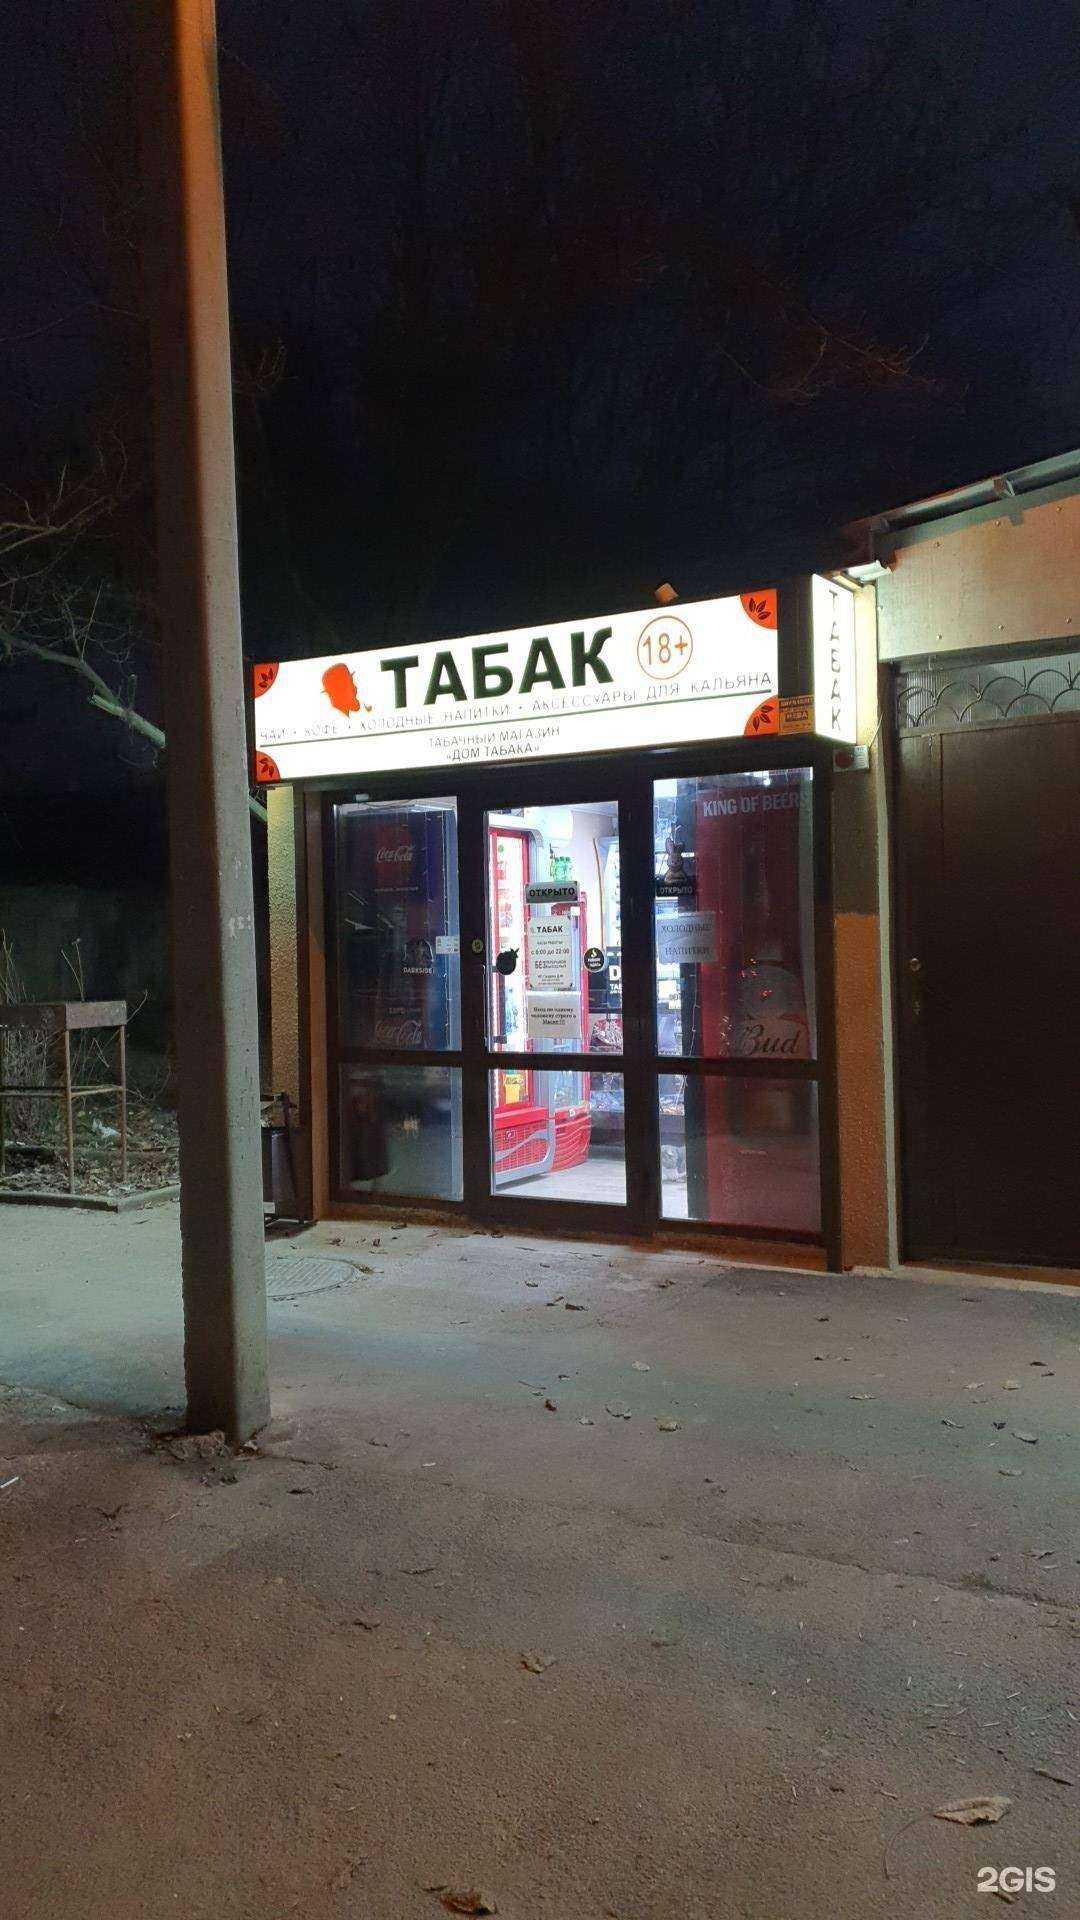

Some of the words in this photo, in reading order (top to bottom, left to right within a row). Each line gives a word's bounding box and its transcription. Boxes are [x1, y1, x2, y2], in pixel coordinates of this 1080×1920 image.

[643, 632, 689, 666] 18+
[380, 626, 614, 709] ТАБАК
[828, 590, 842, 732] ТАБАК
[360, 714, 433, 732] ХОЛОДНЫЕ
[444, 704, 511, 722] НАПИТКИ
[532, 689, 637, 712] АКСЕССУАРЫ
[646, 683, 681, 702] ДЛЯ
[691, 672, 773, 693] КАЛЬЯНА
[428, 732, 496, 748] ТАБАЧНЫЙ
[499, 726, 561, 742] МАГАЗИН
[703, 798, 738, 817] KING
[740, 796, 761, 813] OF
[529, 886, 576, 898] ОТКРЫТО
[660, 886, 693, 895] ОТКРЫТО
[536, 925, 563, 934] ТАБАК
[403, 966, 433, 975] DARKSIDE
[741, 1023, 800, 1056] Bud
